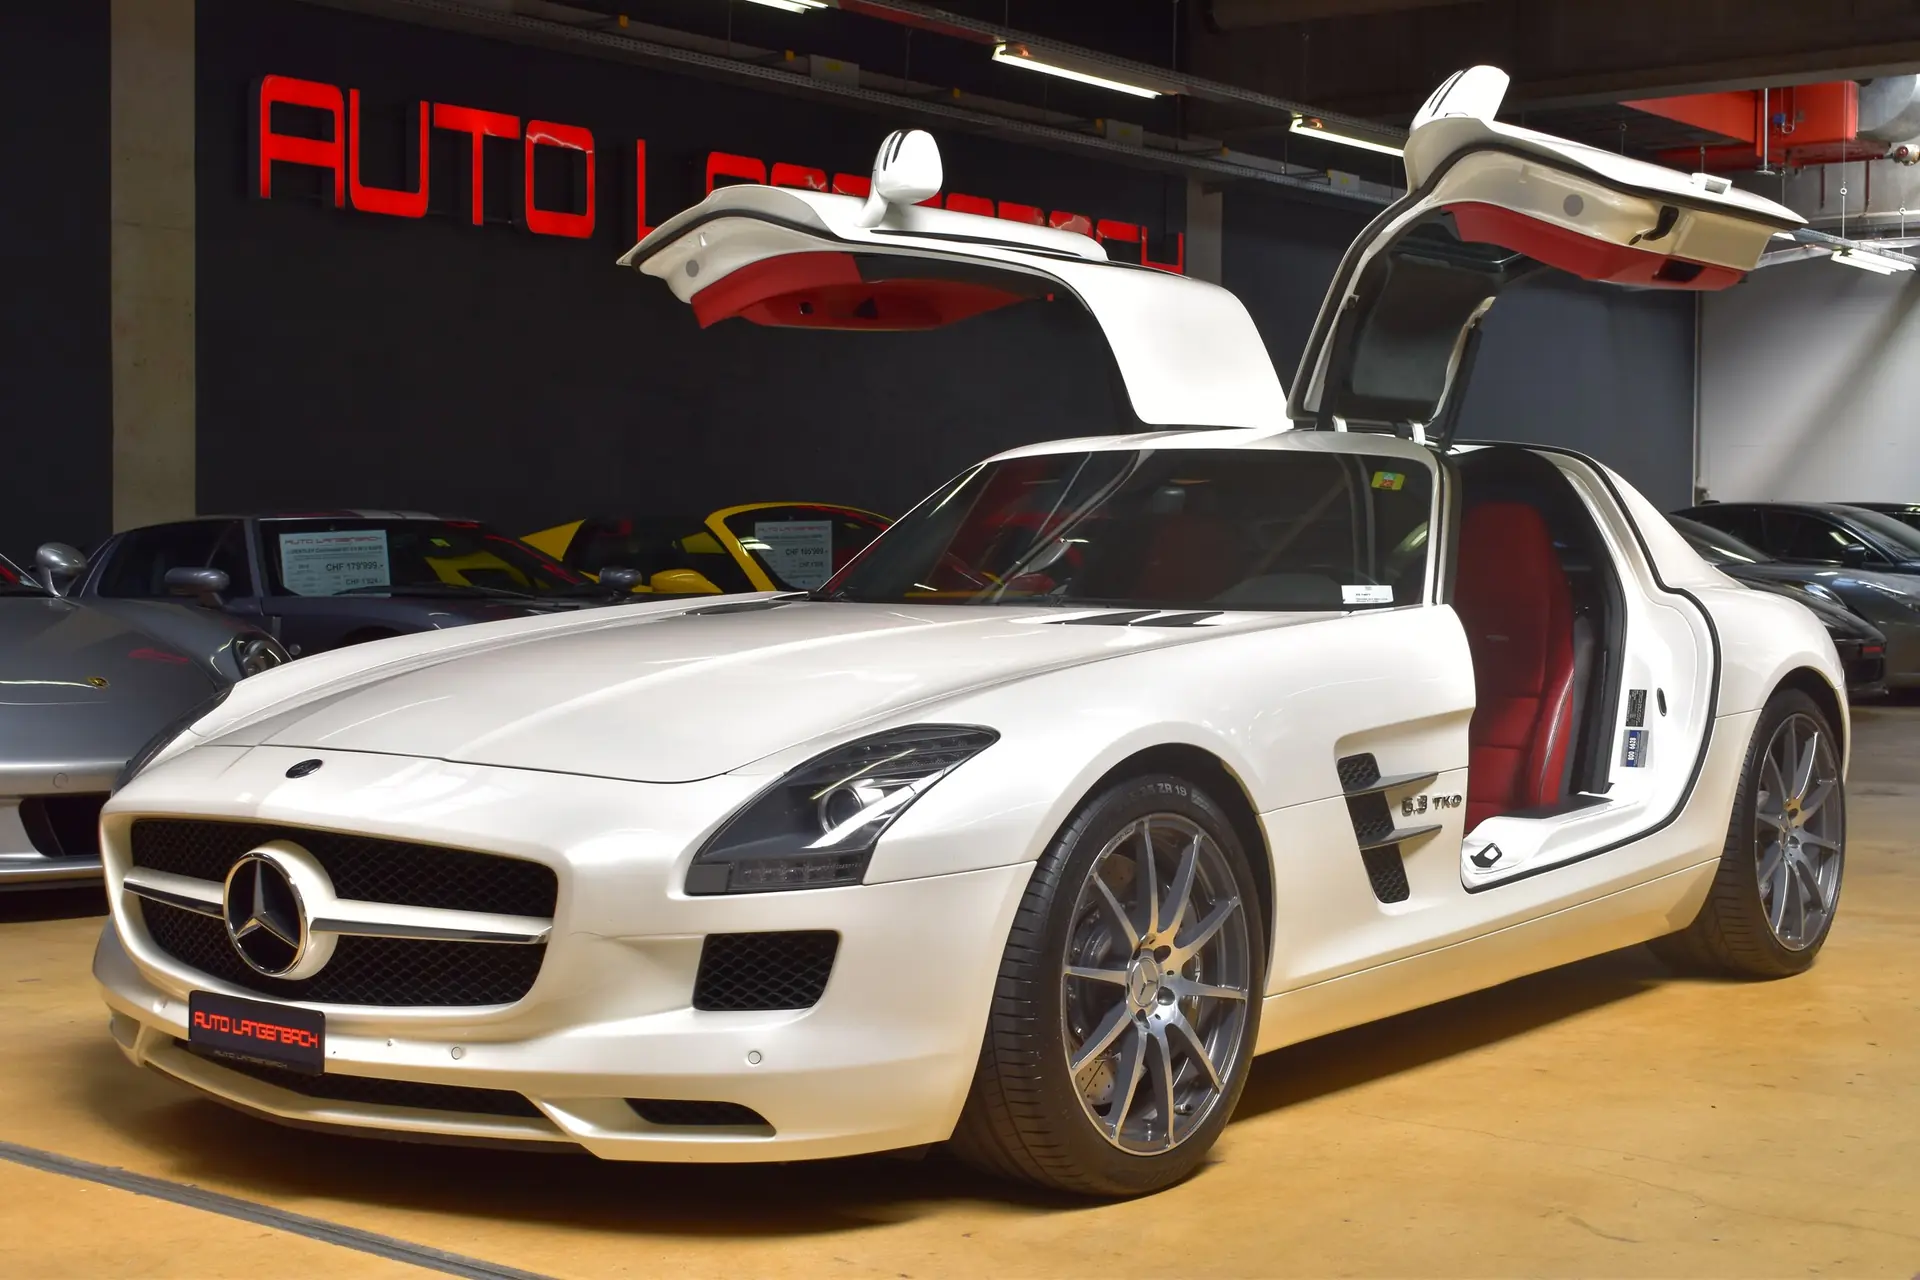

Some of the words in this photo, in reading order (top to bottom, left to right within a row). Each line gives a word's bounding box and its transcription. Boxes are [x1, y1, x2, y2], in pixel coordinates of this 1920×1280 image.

[260, 74, 596, 239] AUTO
[326, 562, 344, 572] CHF
[1156, 783, 1173, 794] ZR
[1174, 784, 1188, 797] 19
[1401, 794, 1428, 817] 6.3
[194, 1010, 229, 1033] AUTO
[232, 1018, 319, 1049] LANGENBACH
